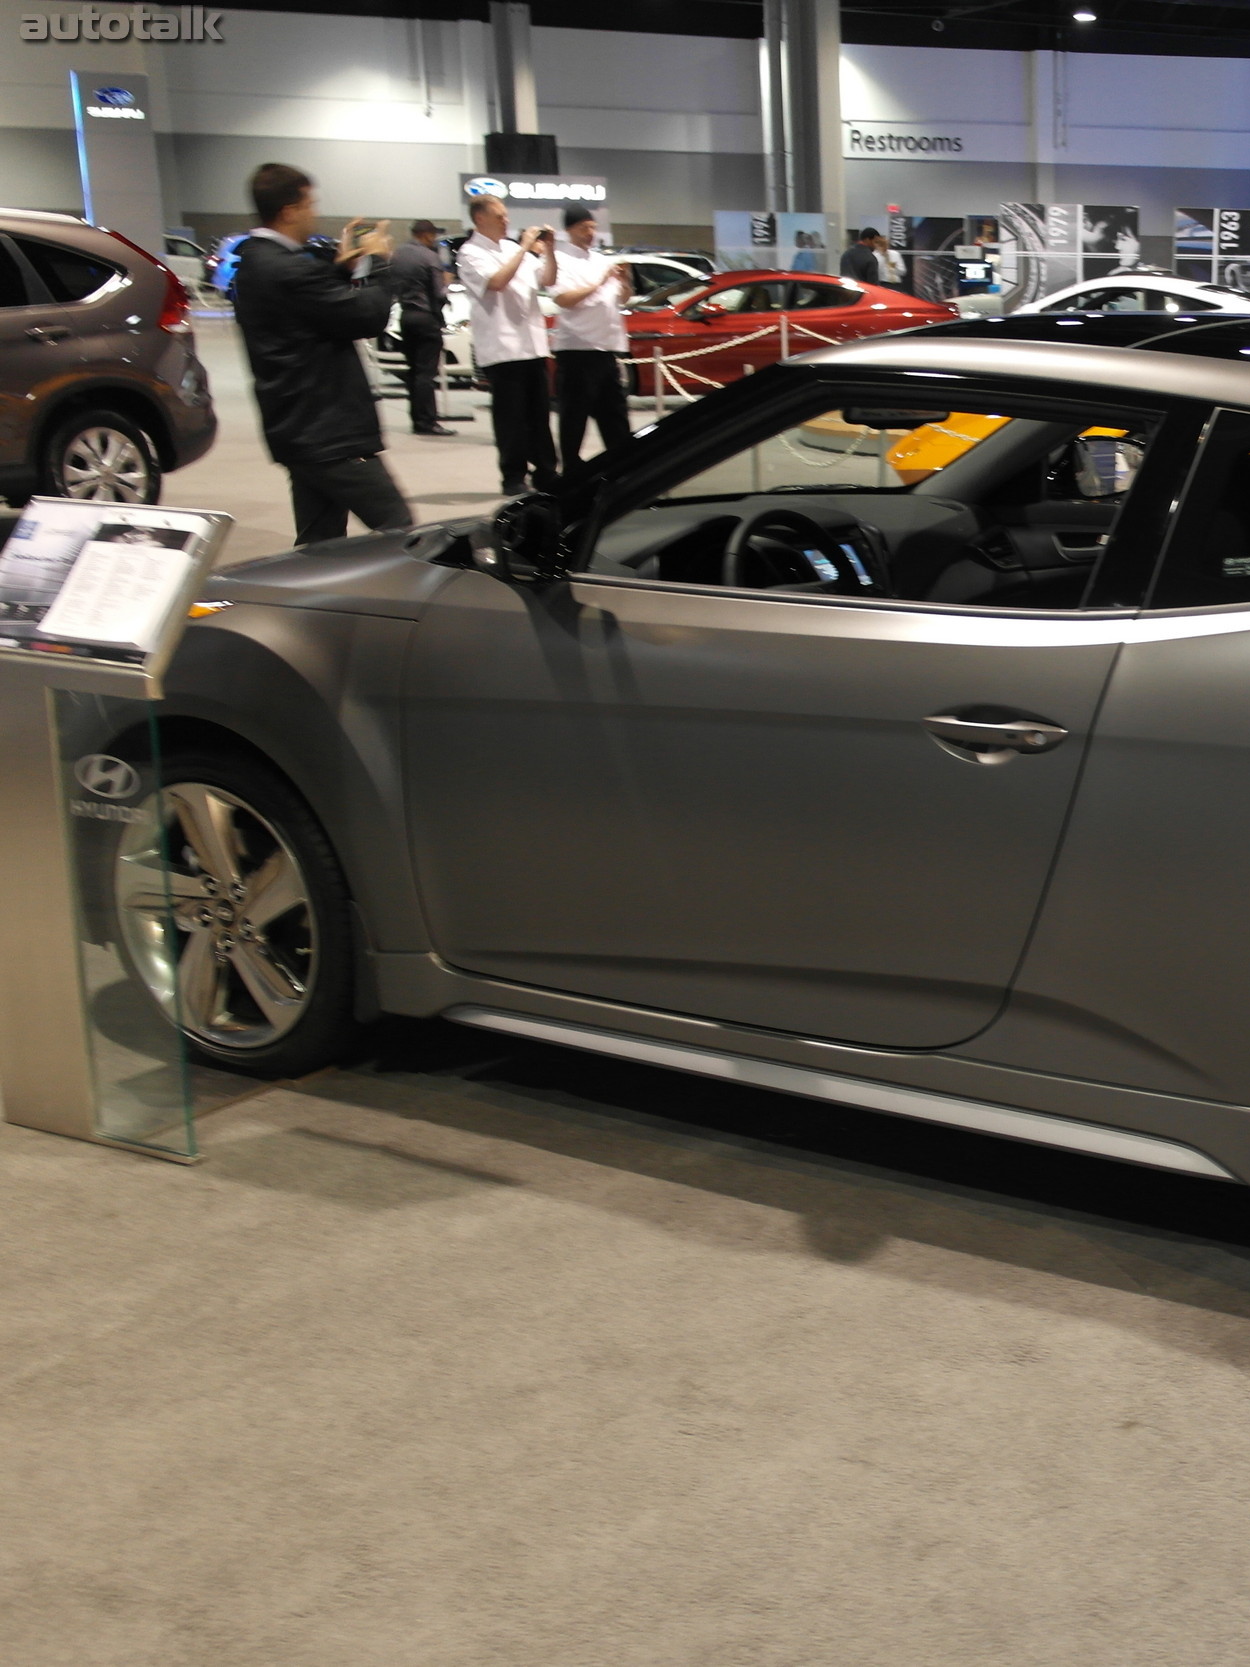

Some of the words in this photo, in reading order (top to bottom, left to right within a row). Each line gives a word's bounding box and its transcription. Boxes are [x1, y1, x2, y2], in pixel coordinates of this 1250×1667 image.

[851, 129, 963, 152] Restrooms
[508, 182, 606, 200] SUBARU
[890, 217, 907, 248] 2004
[1050, 206, 1068, 247] 1979
[1219, 210, 1241, 250] 1963
